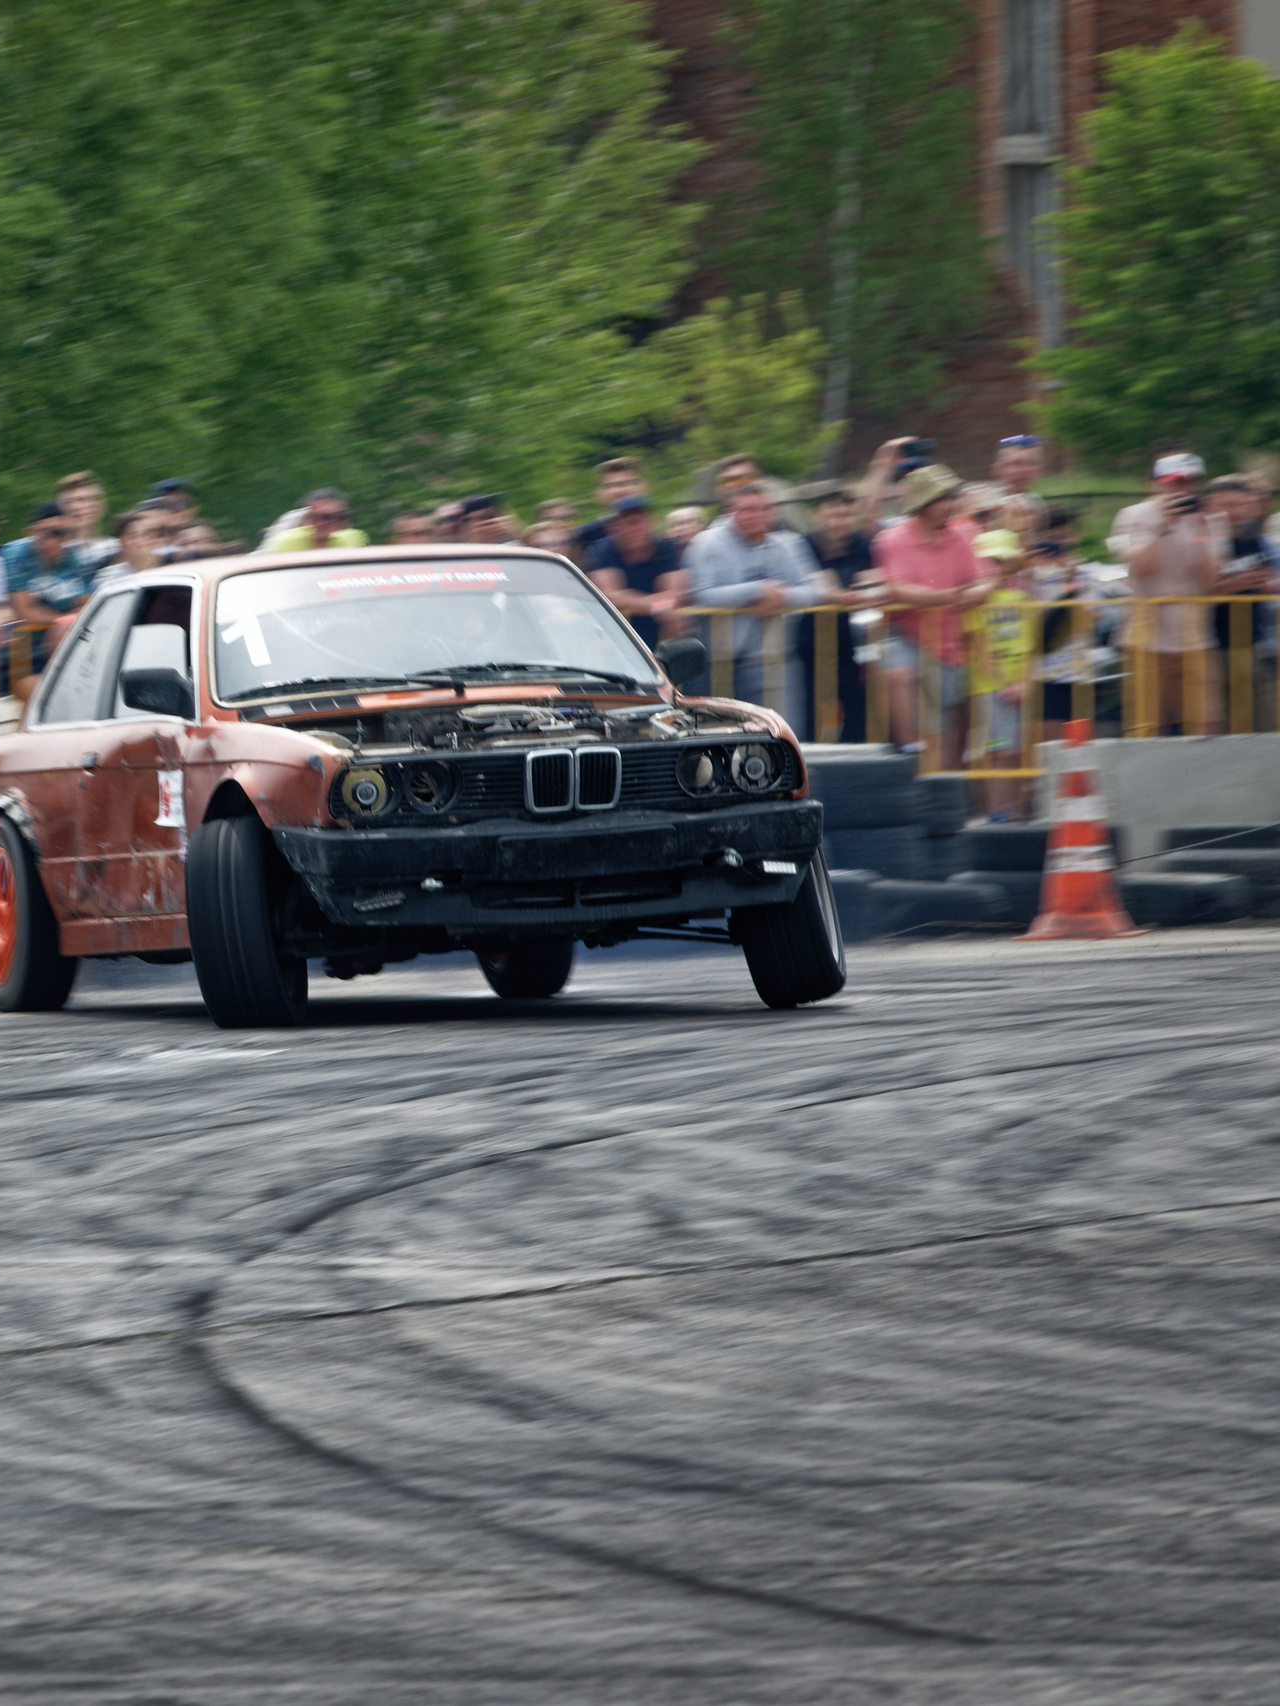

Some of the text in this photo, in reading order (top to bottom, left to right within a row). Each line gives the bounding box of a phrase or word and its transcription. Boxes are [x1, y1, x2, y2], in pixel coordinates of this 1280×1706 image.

[318, 575, 405, 590] FORMULA
[404, 572, 453, 584] DRIFT
[221, 612, 271, 667] 1
